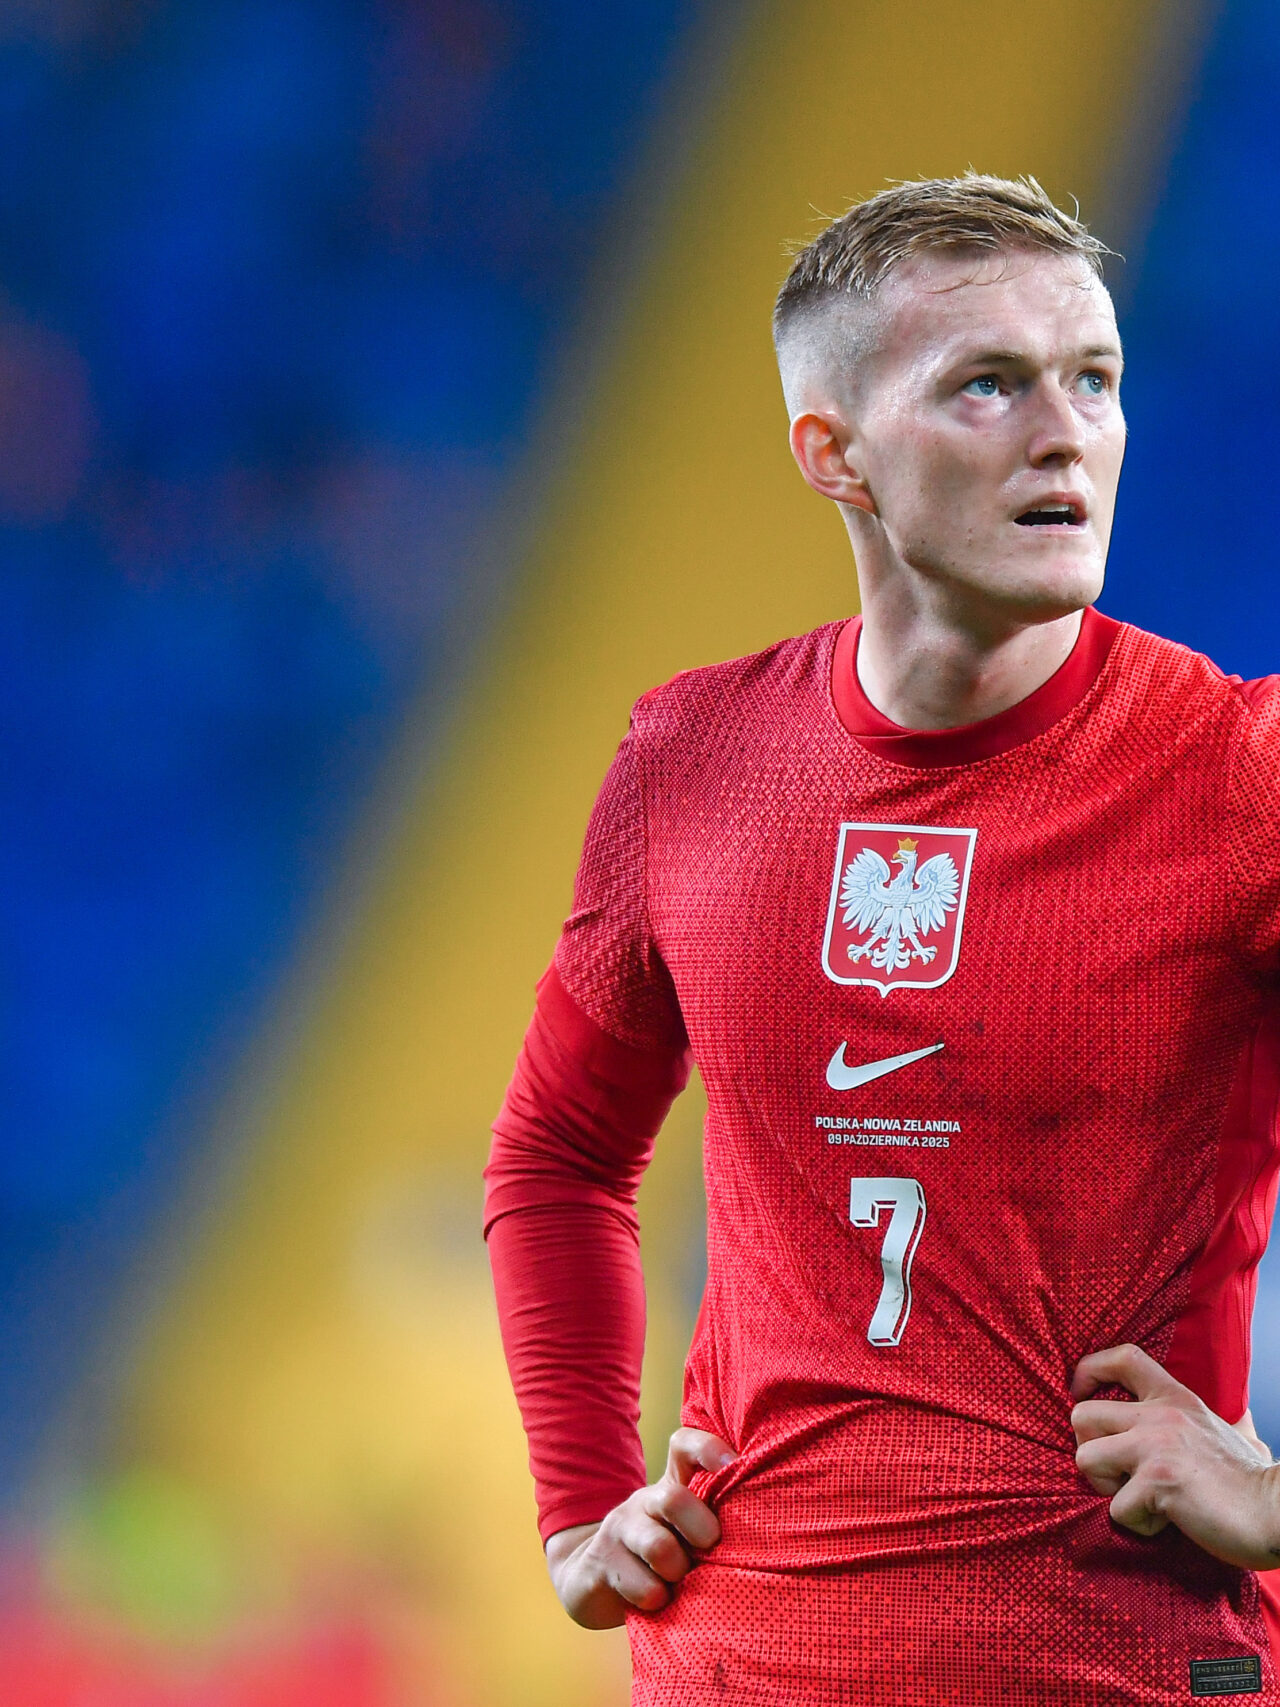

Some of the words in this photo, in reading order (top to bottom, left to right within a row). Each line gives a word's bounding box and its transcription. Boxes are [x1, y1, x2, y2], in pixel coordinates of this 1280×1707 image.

[815, 1116, 902, 1131] POLSKA-NOWA
[903, 1119, 961, 1133] ZELANDIA
[828, 1133, 842, 1144] 09
[843, 1132, 920, 1147] PAŹDZIERNIKA
[921, 1136, 950, 1148] 2025
[849, 1177, 927, 1347] 7
